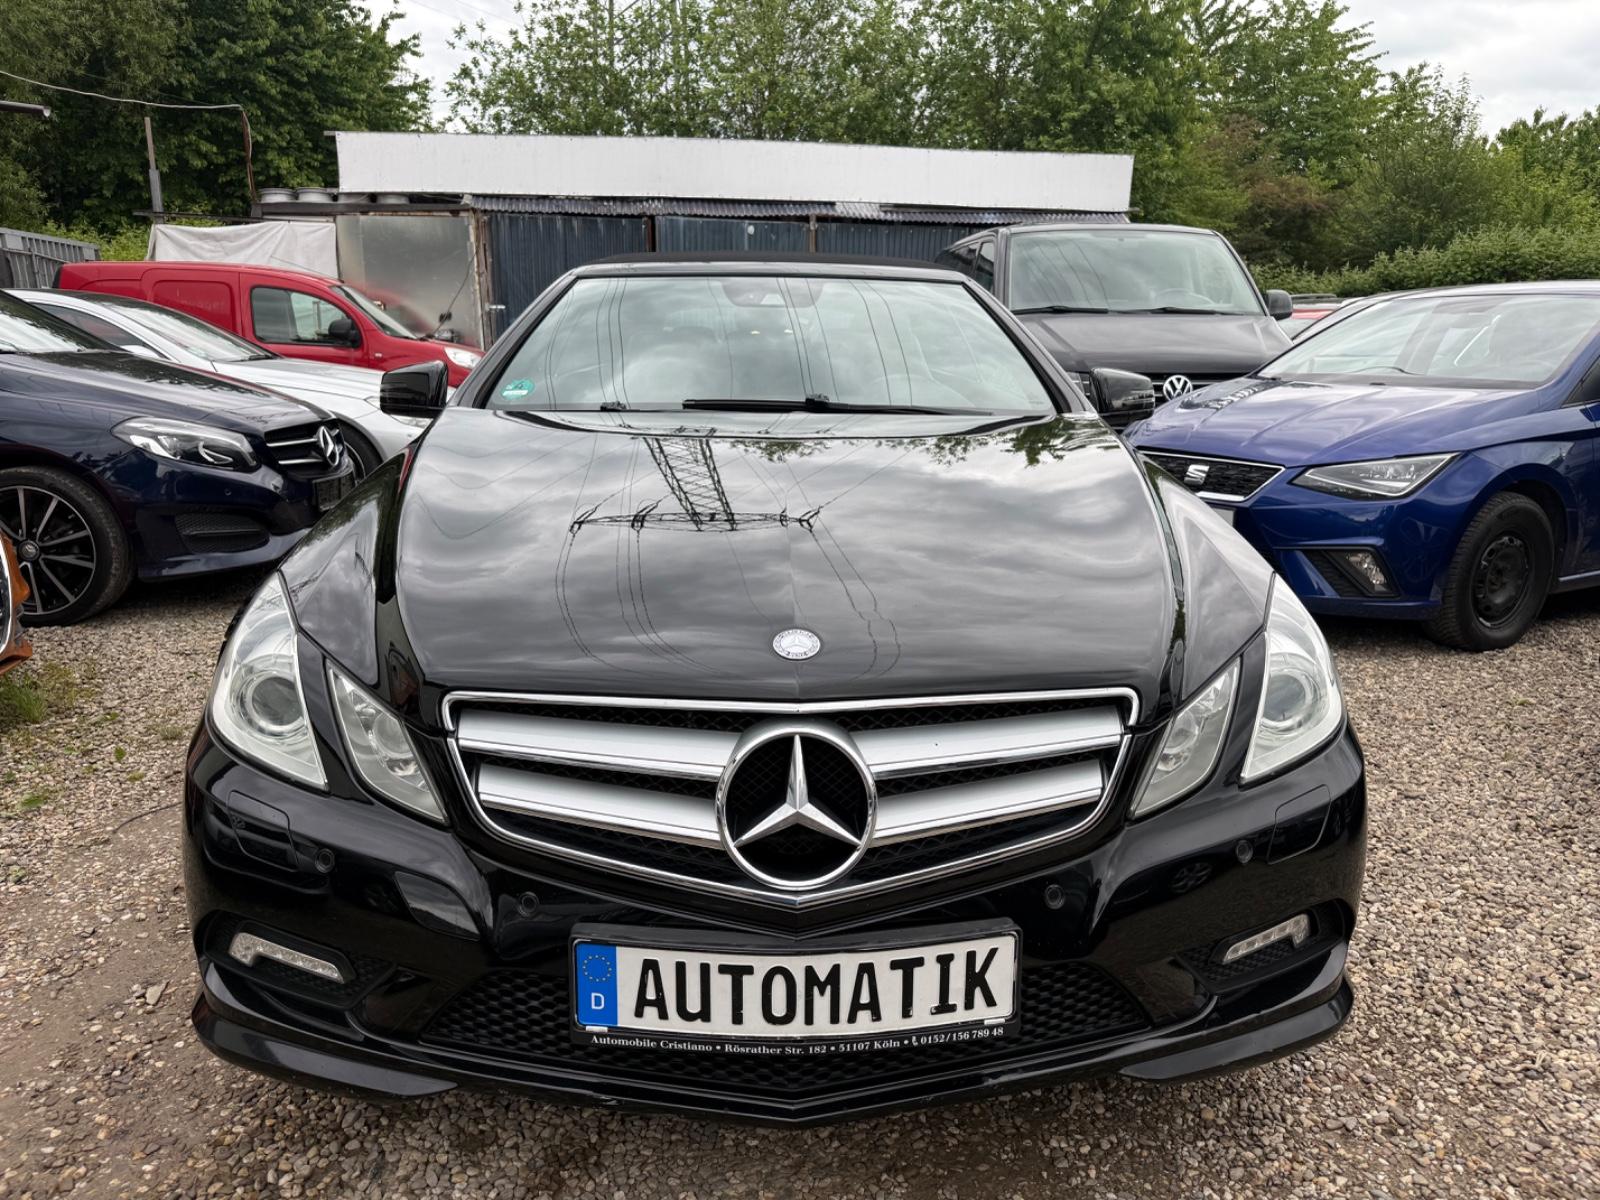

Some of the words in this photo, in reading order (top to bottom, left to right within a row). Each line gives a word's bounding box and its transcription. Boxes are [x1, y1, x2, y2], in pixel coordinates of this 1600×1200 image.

[634, 947, 999, 1026] AUTOMATIK
[591, 993, 605, 1010] D
[591, 1035, 657, 1048] Automobile
[660, 1040, 712, 1052] Cristiano
[725, 1043, 782, 1054] Rösrather
[785, 1045, 804, 1054] Str.
[808, 1045, 827, 1054] 182
[838, 1041, 870, 1052] 51107
[874, 1039, 900, 1050] Köln
[920, 1032, 970, 1045] 0152/156
[972, 1029, 990, 1039] 789
[991, 1027, 1004, 1036] 48
